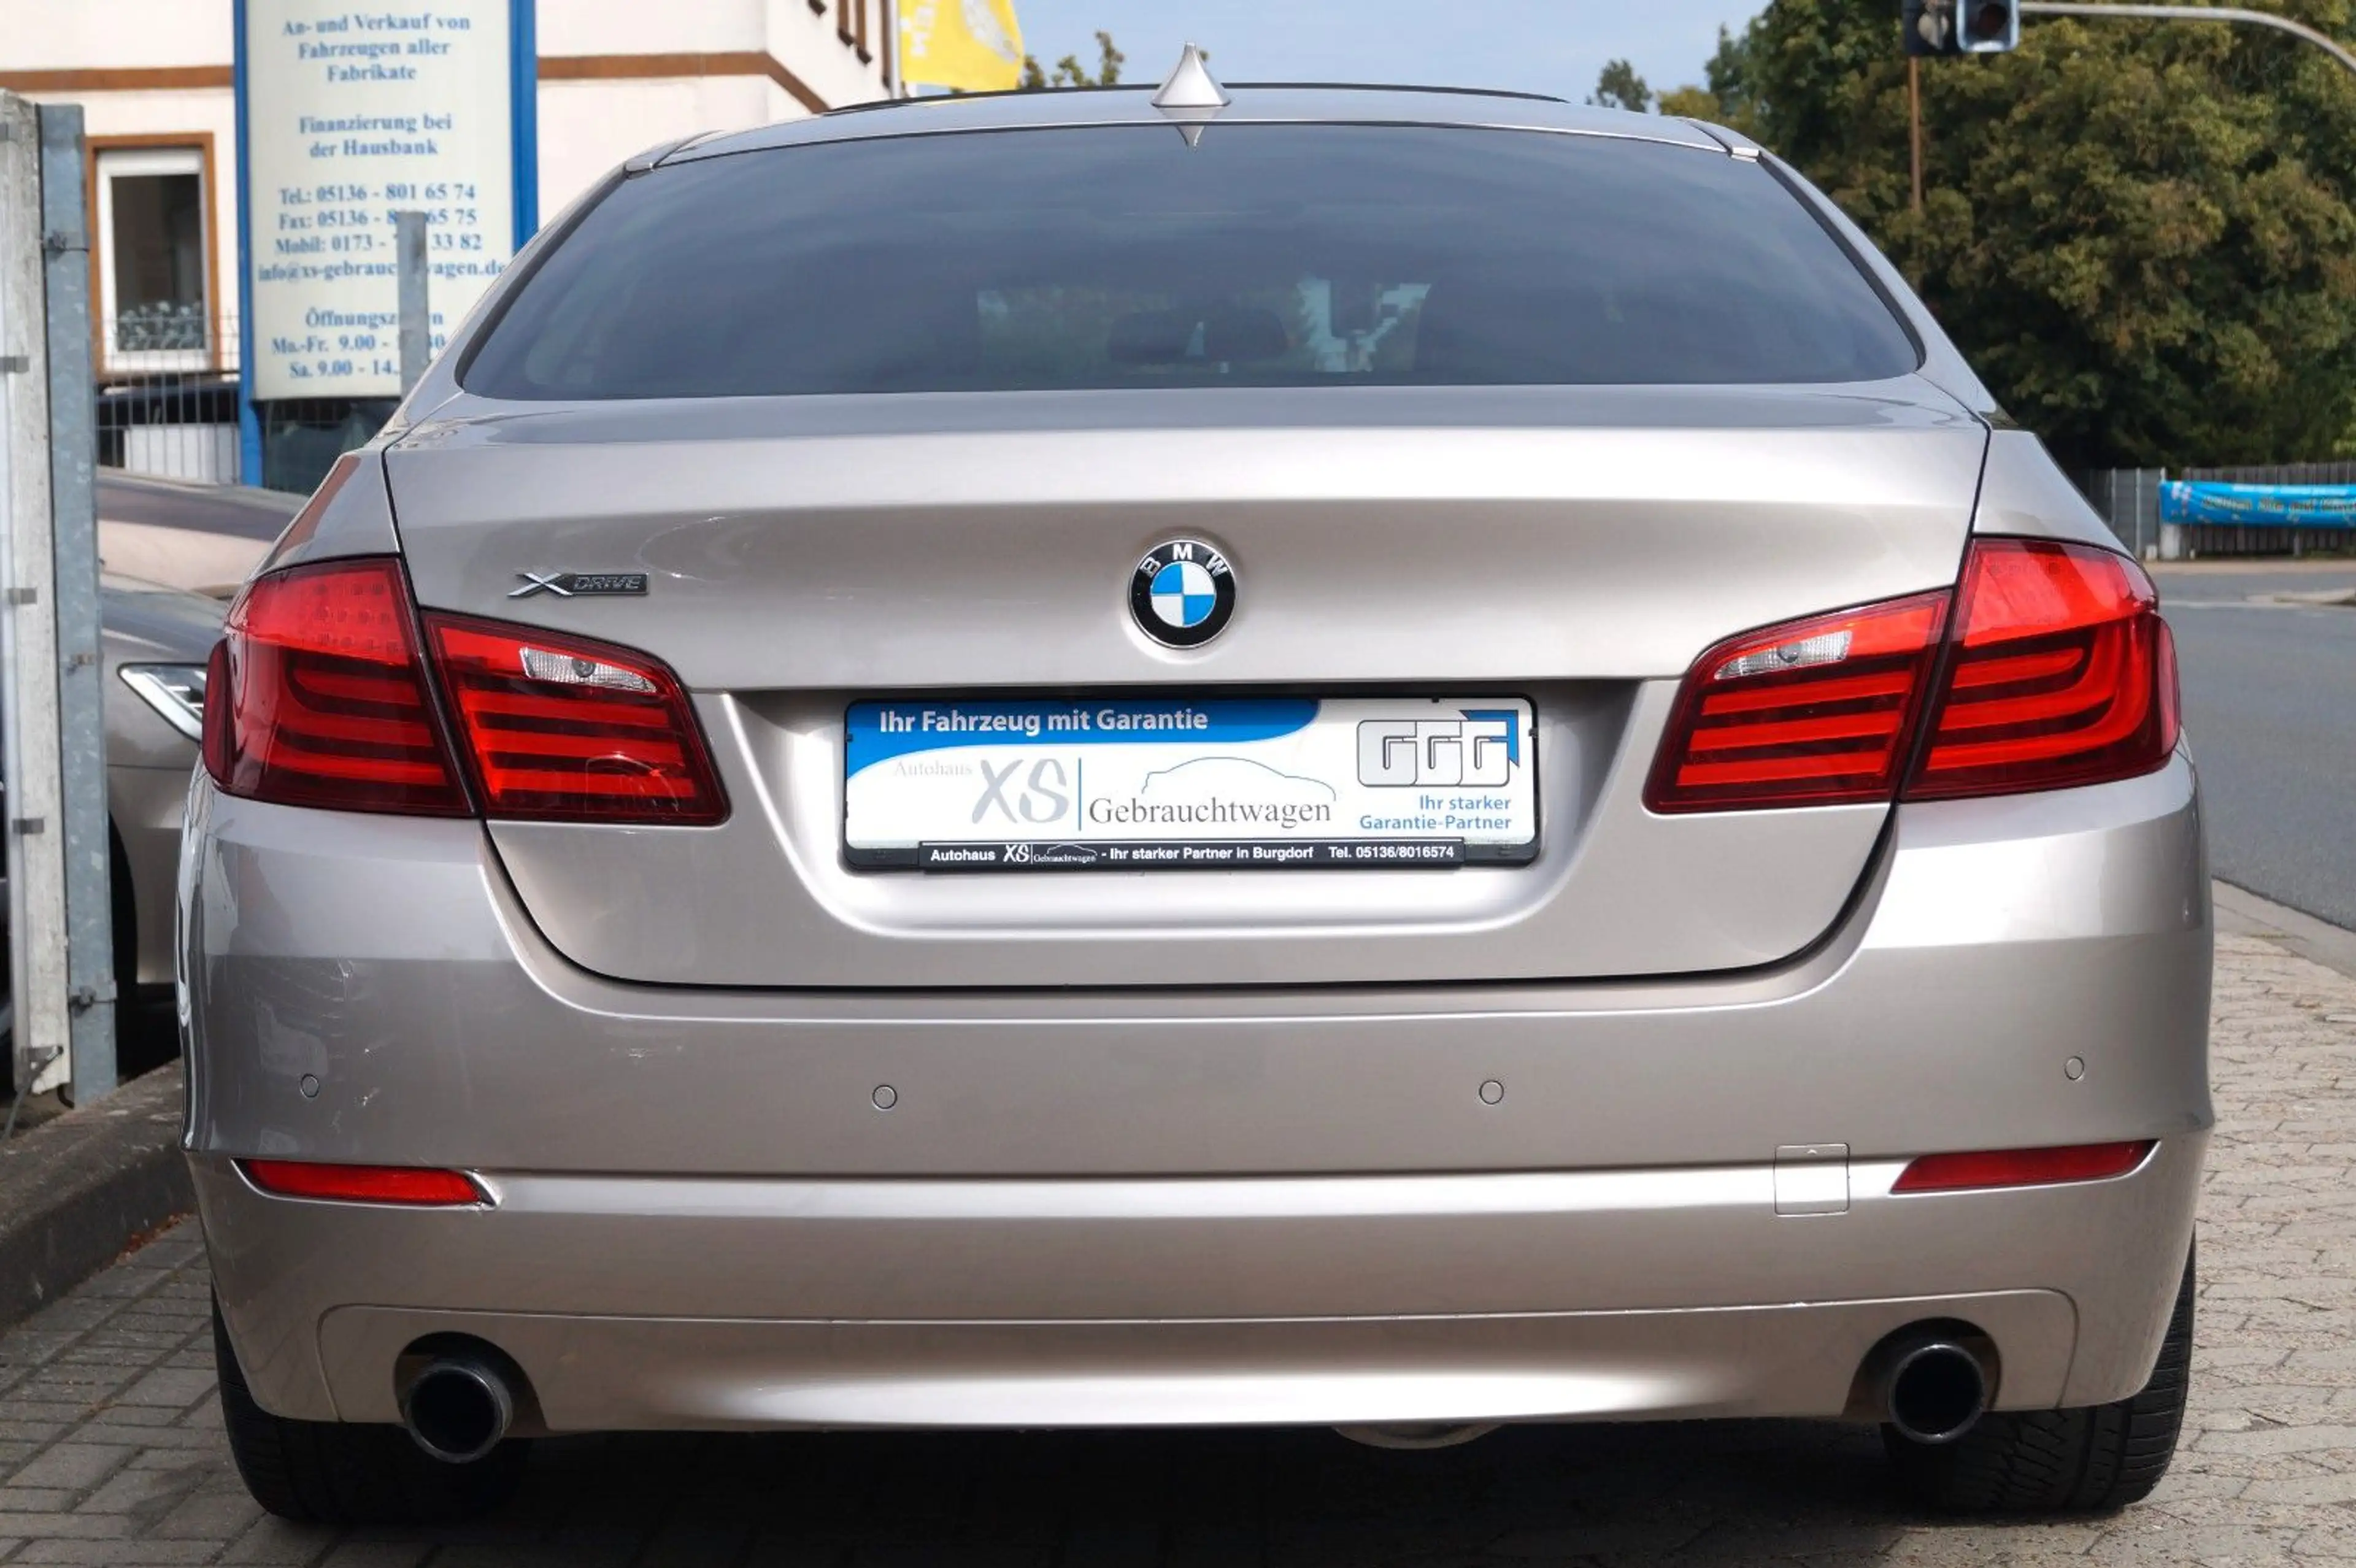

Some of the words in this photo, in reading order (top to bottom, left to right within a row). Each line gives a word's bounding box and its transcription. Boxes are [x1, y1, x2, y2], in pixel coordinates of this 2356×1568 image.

[282, 20, 311, 36] An-
[316, 15, 348, 33] und
[354, 13, 433, 31] Verkauf
[436, 16, 471, 31] von
[298, 40, 401, 60] Fahrzeugen
[407, 39, 451, 55] aller
[327, 64, 417, 82] Fabrikate
[299, 115, 418, 134] Finanzierung
[423, 113, 452, 130] bei
[309, 141, 337, 158] der
[342, 139, 439, 156] Hausbank
[279, 188, 312, 205] Tel.:
[317, 185, 367, 202] 05136
[385, 185, 417, 200] 801
[425, 183, 448, 199] 65
[455, 183, 475, 199] 74
[278, 212, 312, 231] Fax:
[317, 210, 368, 227] 05136
[455, 209, 477, 225] 75
[275, 236, 326, 255] Mobil:
[331, 234, 372, 252] 0173
[431, 233, 453, 250] 33
[460, 233, 482, 250] 82
[339, 334, 375, 352] 9.00
[289, 361, 313, 379] Sa.
[317, 359, 353, 377] 9.00
[1139, 543, 1229, 578] BMW
[880, 711, 915, 732] Ihr
[922, 710, 1041, 736] Fahrzeug
[1047, 710, 1090, 731] mit
[1096, 708, 1209, 731] Garantie
[894, 759, 974, 777] Autohaus
[972, 758, 1070, 824] XS
[1419, 795, 1444, 810] Ihr
[1449, 794, 1511, 810] starker
[1088, 797, 1331, 829] Gebrauchtwagen
[1359, 814, 1512, 831] Garantie-Partner
[930, 848, 996, 862] Autohaus
[1003, 844, 1030, 863] XS
[1109, 847, 1129, 859] Ihr
[1132, 847, 1179, 860] starker
[1183, 847, 1233, 860] Partner
[1237, 846, 1249, 859] in
[1253, 845, 1314, 862] Burgdorf
[1328, 847, 1351, 859] Tel.
[1355, 845, 1455, 859] 05136/8016574
